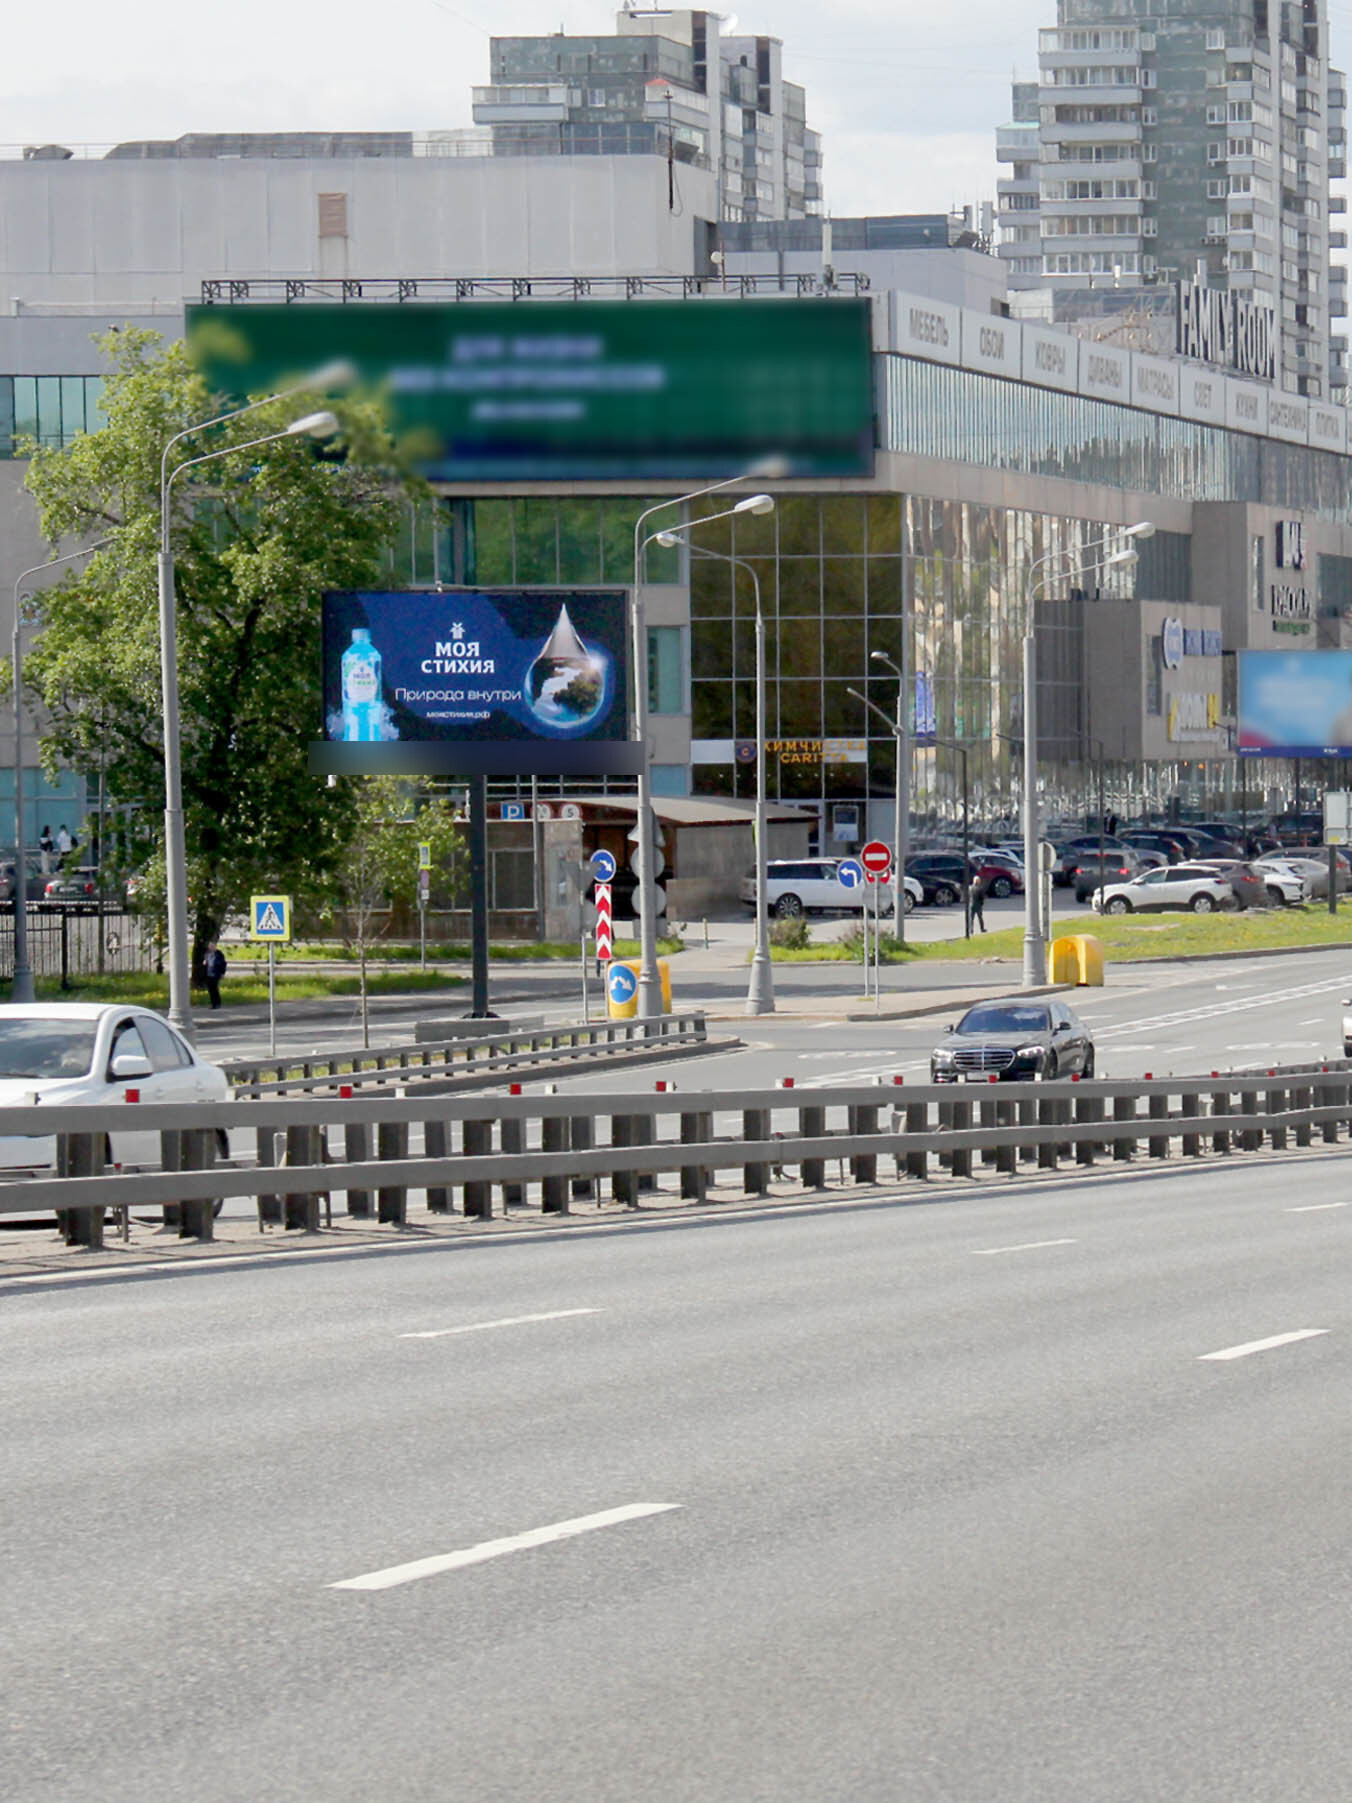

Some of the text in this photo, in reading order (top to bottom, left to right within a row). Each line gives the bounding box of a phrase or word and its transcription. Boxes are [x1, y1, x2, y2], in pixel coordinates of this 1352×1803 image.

[909, 308, 949, 347] МЕБЕЛЬ
[1176, 280, 1276, 379] FAMILY ROOM
[980, 326, 1005, 360] ОБОИ
[435, 641, 480, 657] МОЯ
[421, 659, 495, 674] СТИХИЯ
[395, 688, 522, 703] Природа внутри
[780, 752, 848, 764] CARITTA
